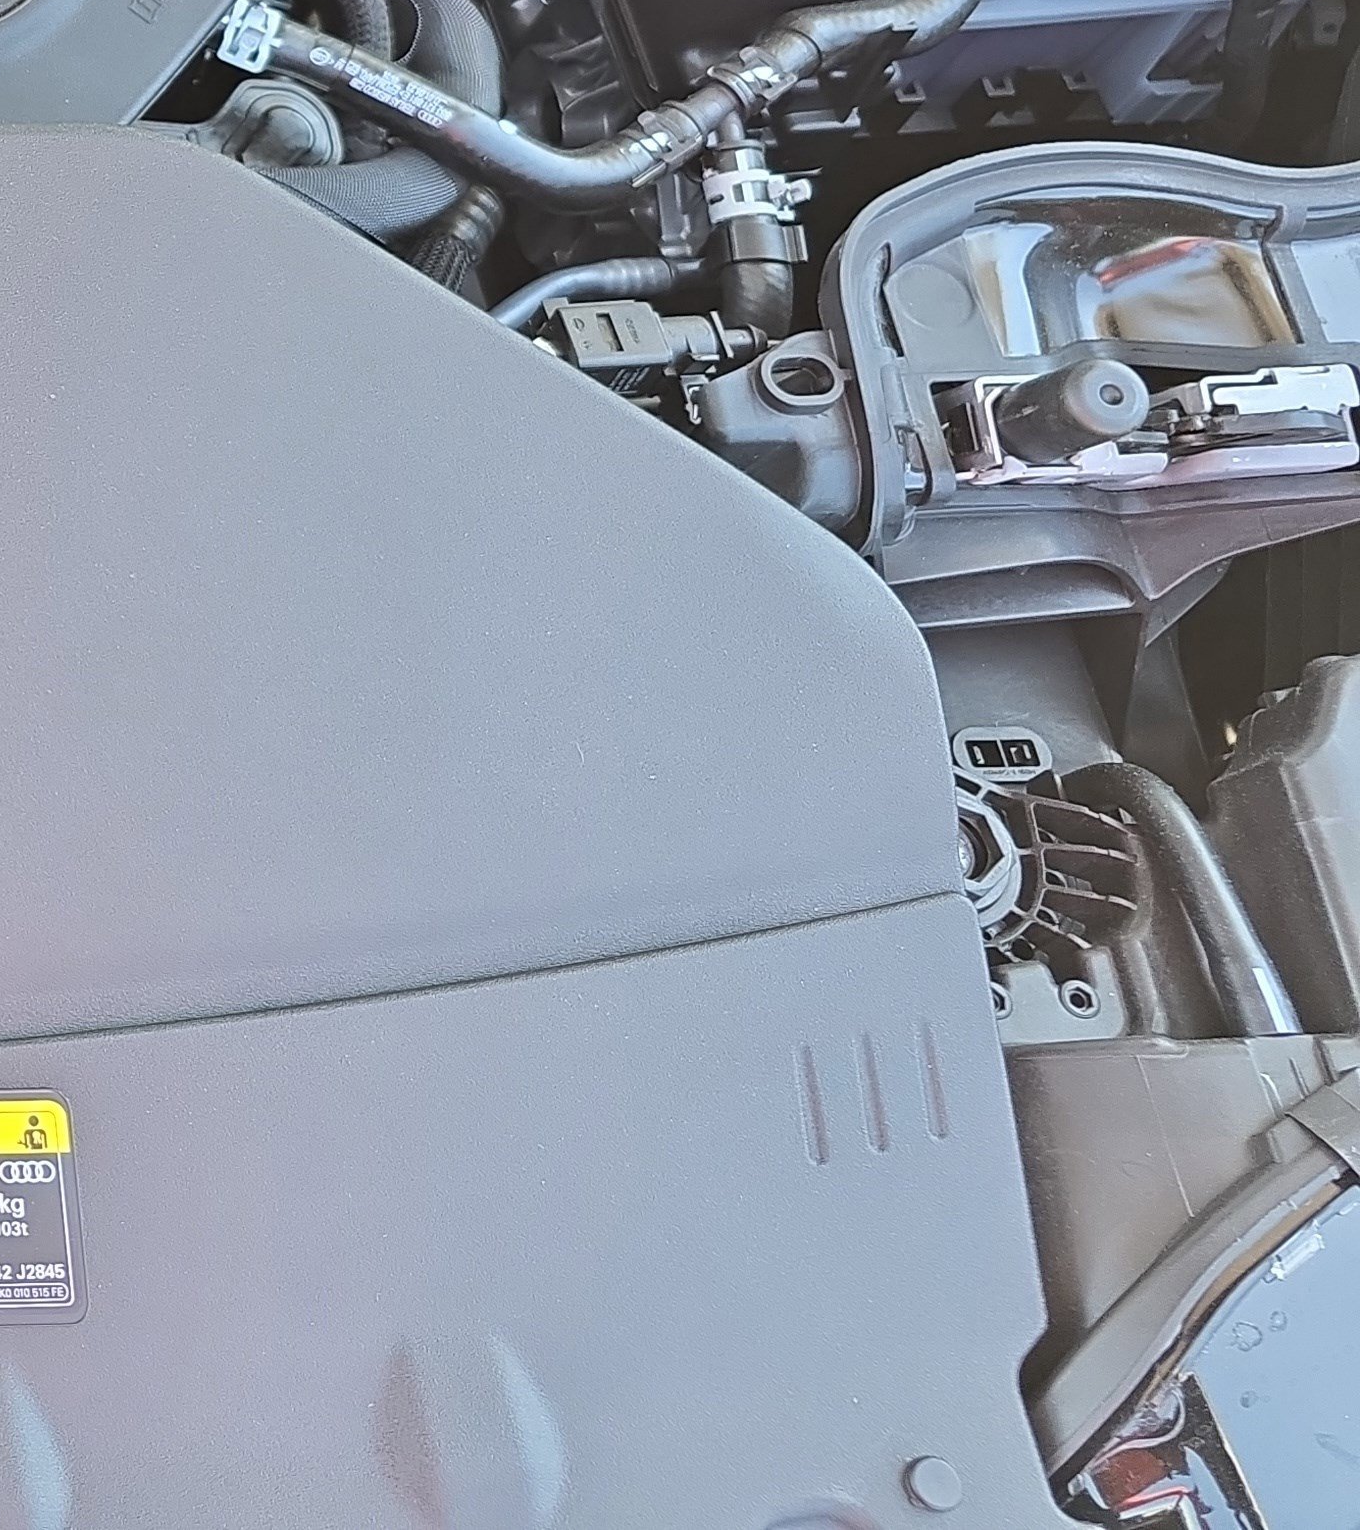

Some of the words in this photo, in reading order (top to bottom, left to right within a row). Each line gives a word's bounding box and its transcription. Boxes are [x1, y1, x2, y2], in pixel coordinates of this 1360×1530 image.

[15, 1263, 66, 1280] J2845
[13, 1287, 31, 1298] 010
[31, 1287, 51, 1298] 515
[51, 1286, 64, 1298] FE
